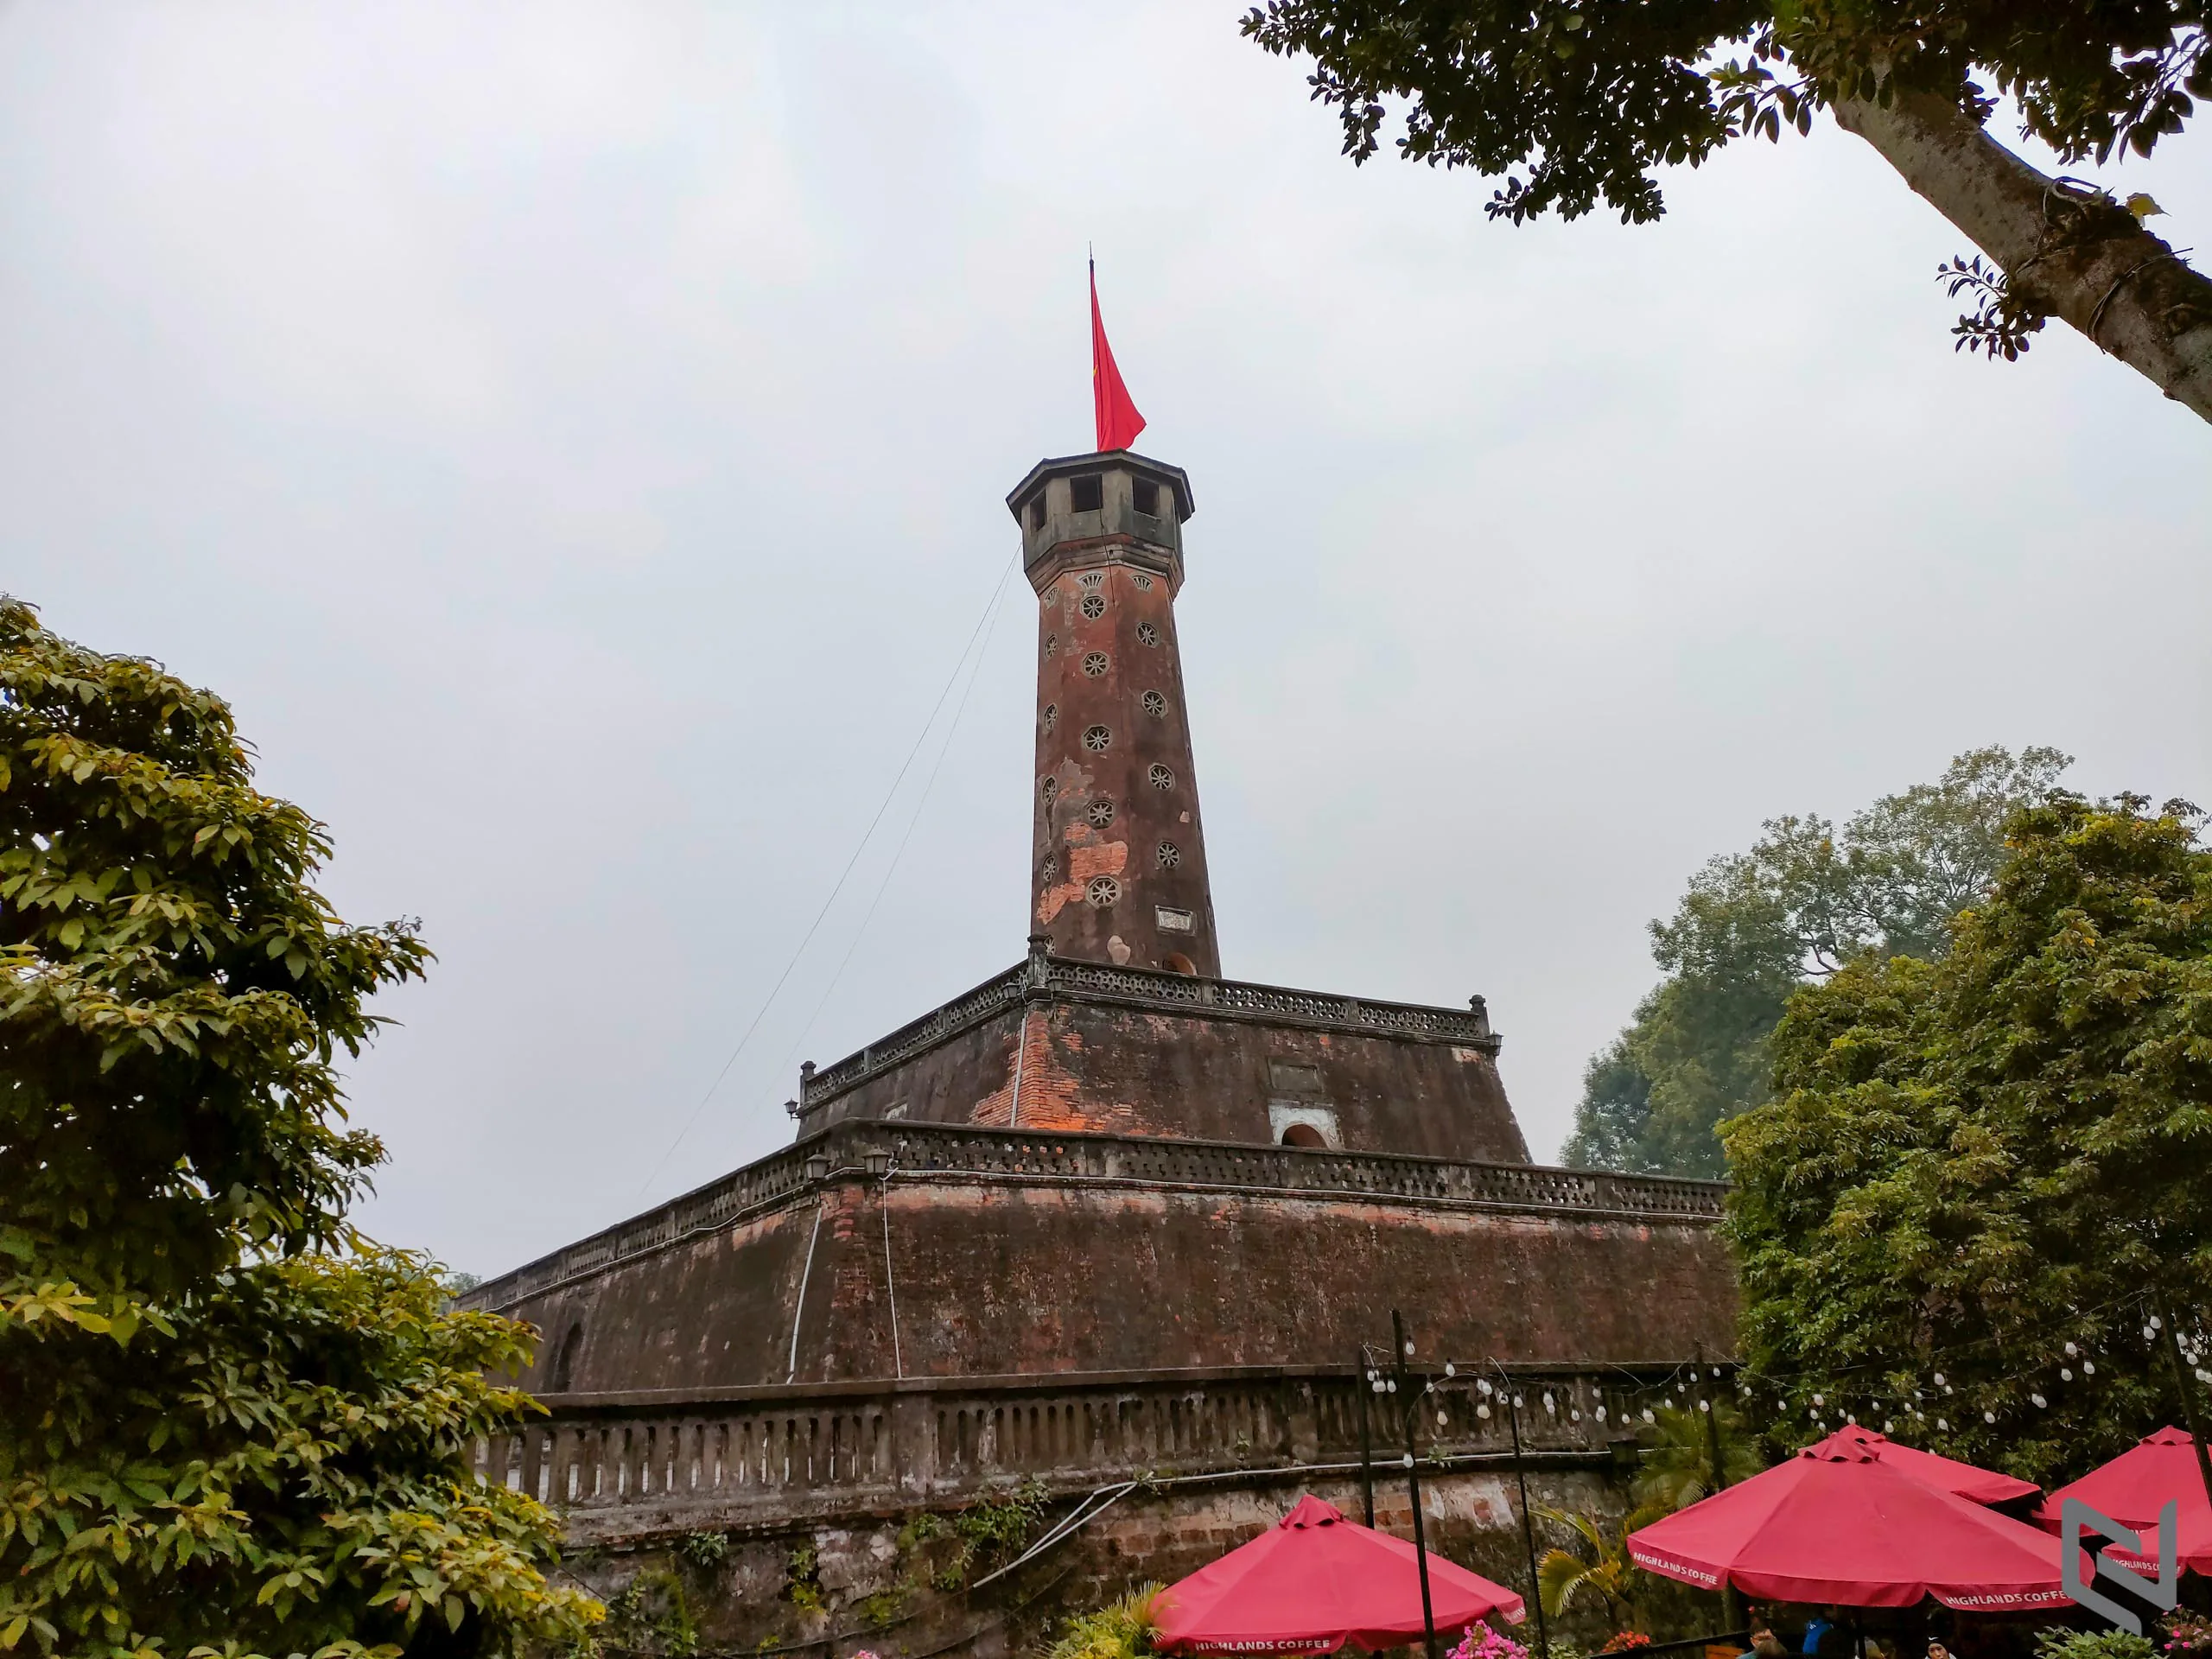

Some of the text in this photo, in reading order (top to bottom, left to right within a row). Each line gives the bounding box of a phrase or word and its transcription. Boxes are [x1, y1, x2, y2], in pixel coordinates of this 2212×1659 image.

[1633, 1552, 1718, 1586] HIGHLANDS COFFEE
[2112, 1559, 2152, 1571] GHLANDS
[1946, 1590, 2070, 1605] HIGHLANDS COFFE
[1195, 1639, 1331, 1651] HIGHLANDS COFFEE
